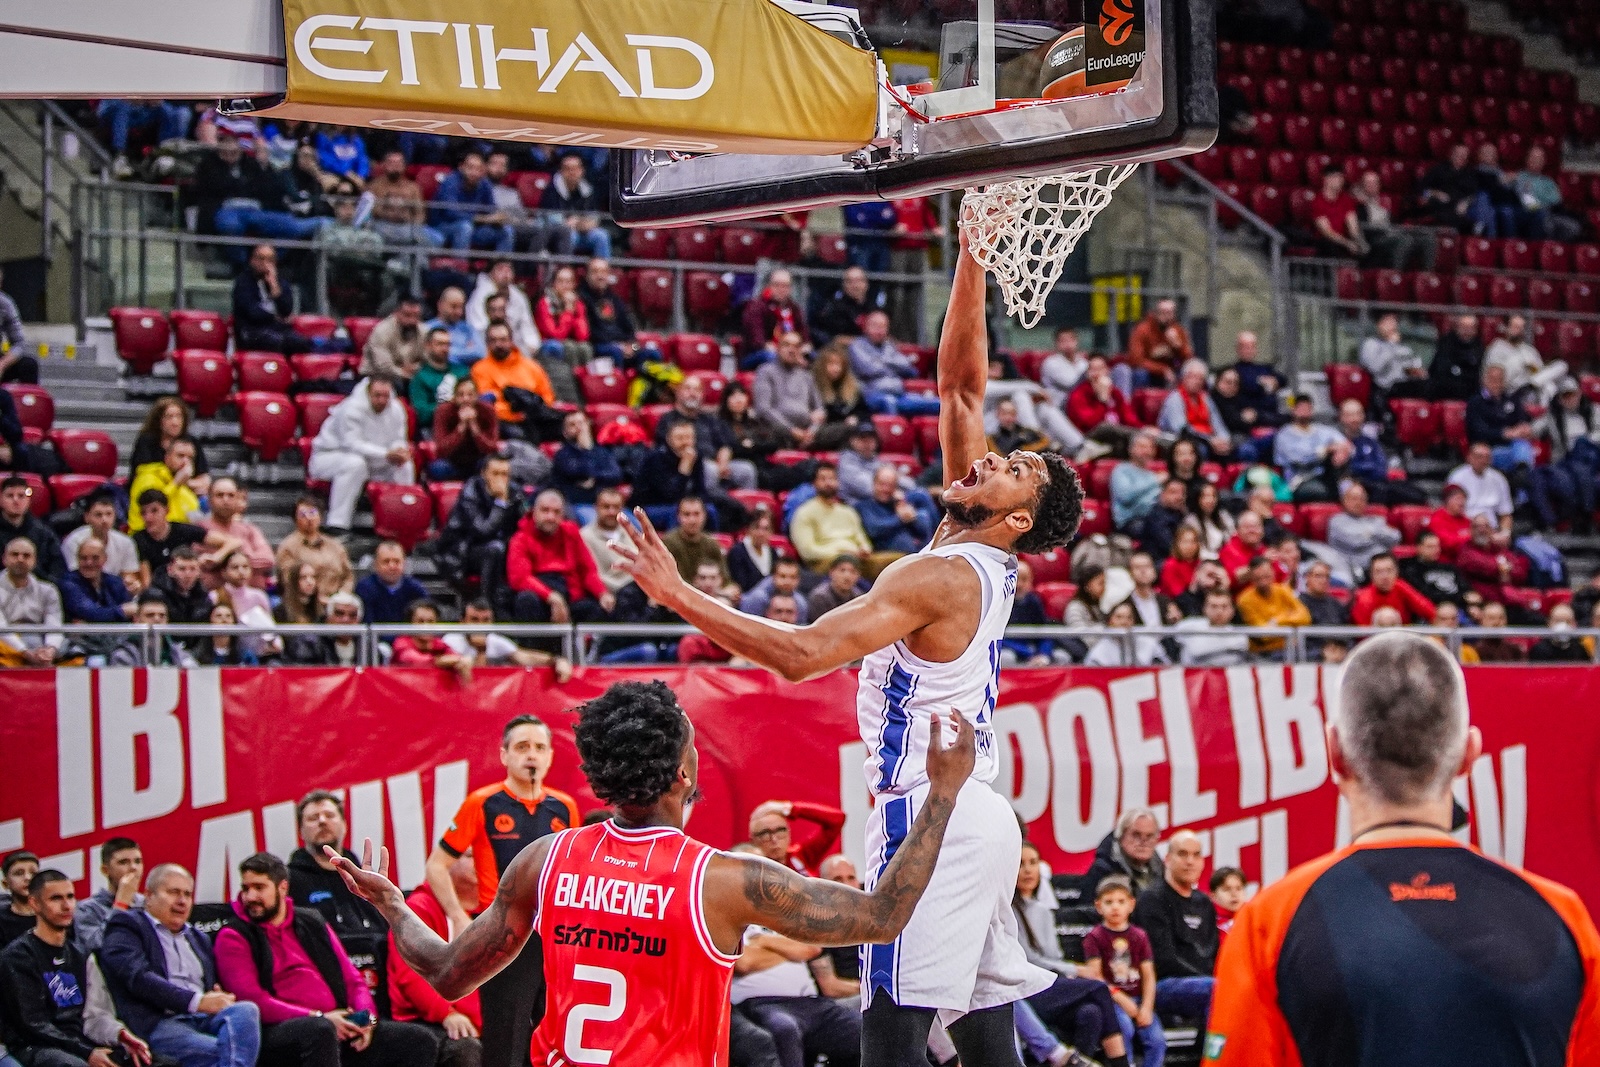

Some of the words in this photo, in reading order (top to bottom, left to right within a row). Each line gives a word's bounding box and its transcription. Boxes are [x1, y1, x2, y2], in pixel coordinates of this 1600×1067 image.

[294, 14, 715, 99] ETIHAD
[1087, 50, 1147, 71] EuroLeague
[55, 667, 227, 839] IBI
[554, 873, 676, 920] BLAKENEY
[564, 964, 627, 1065] 2
